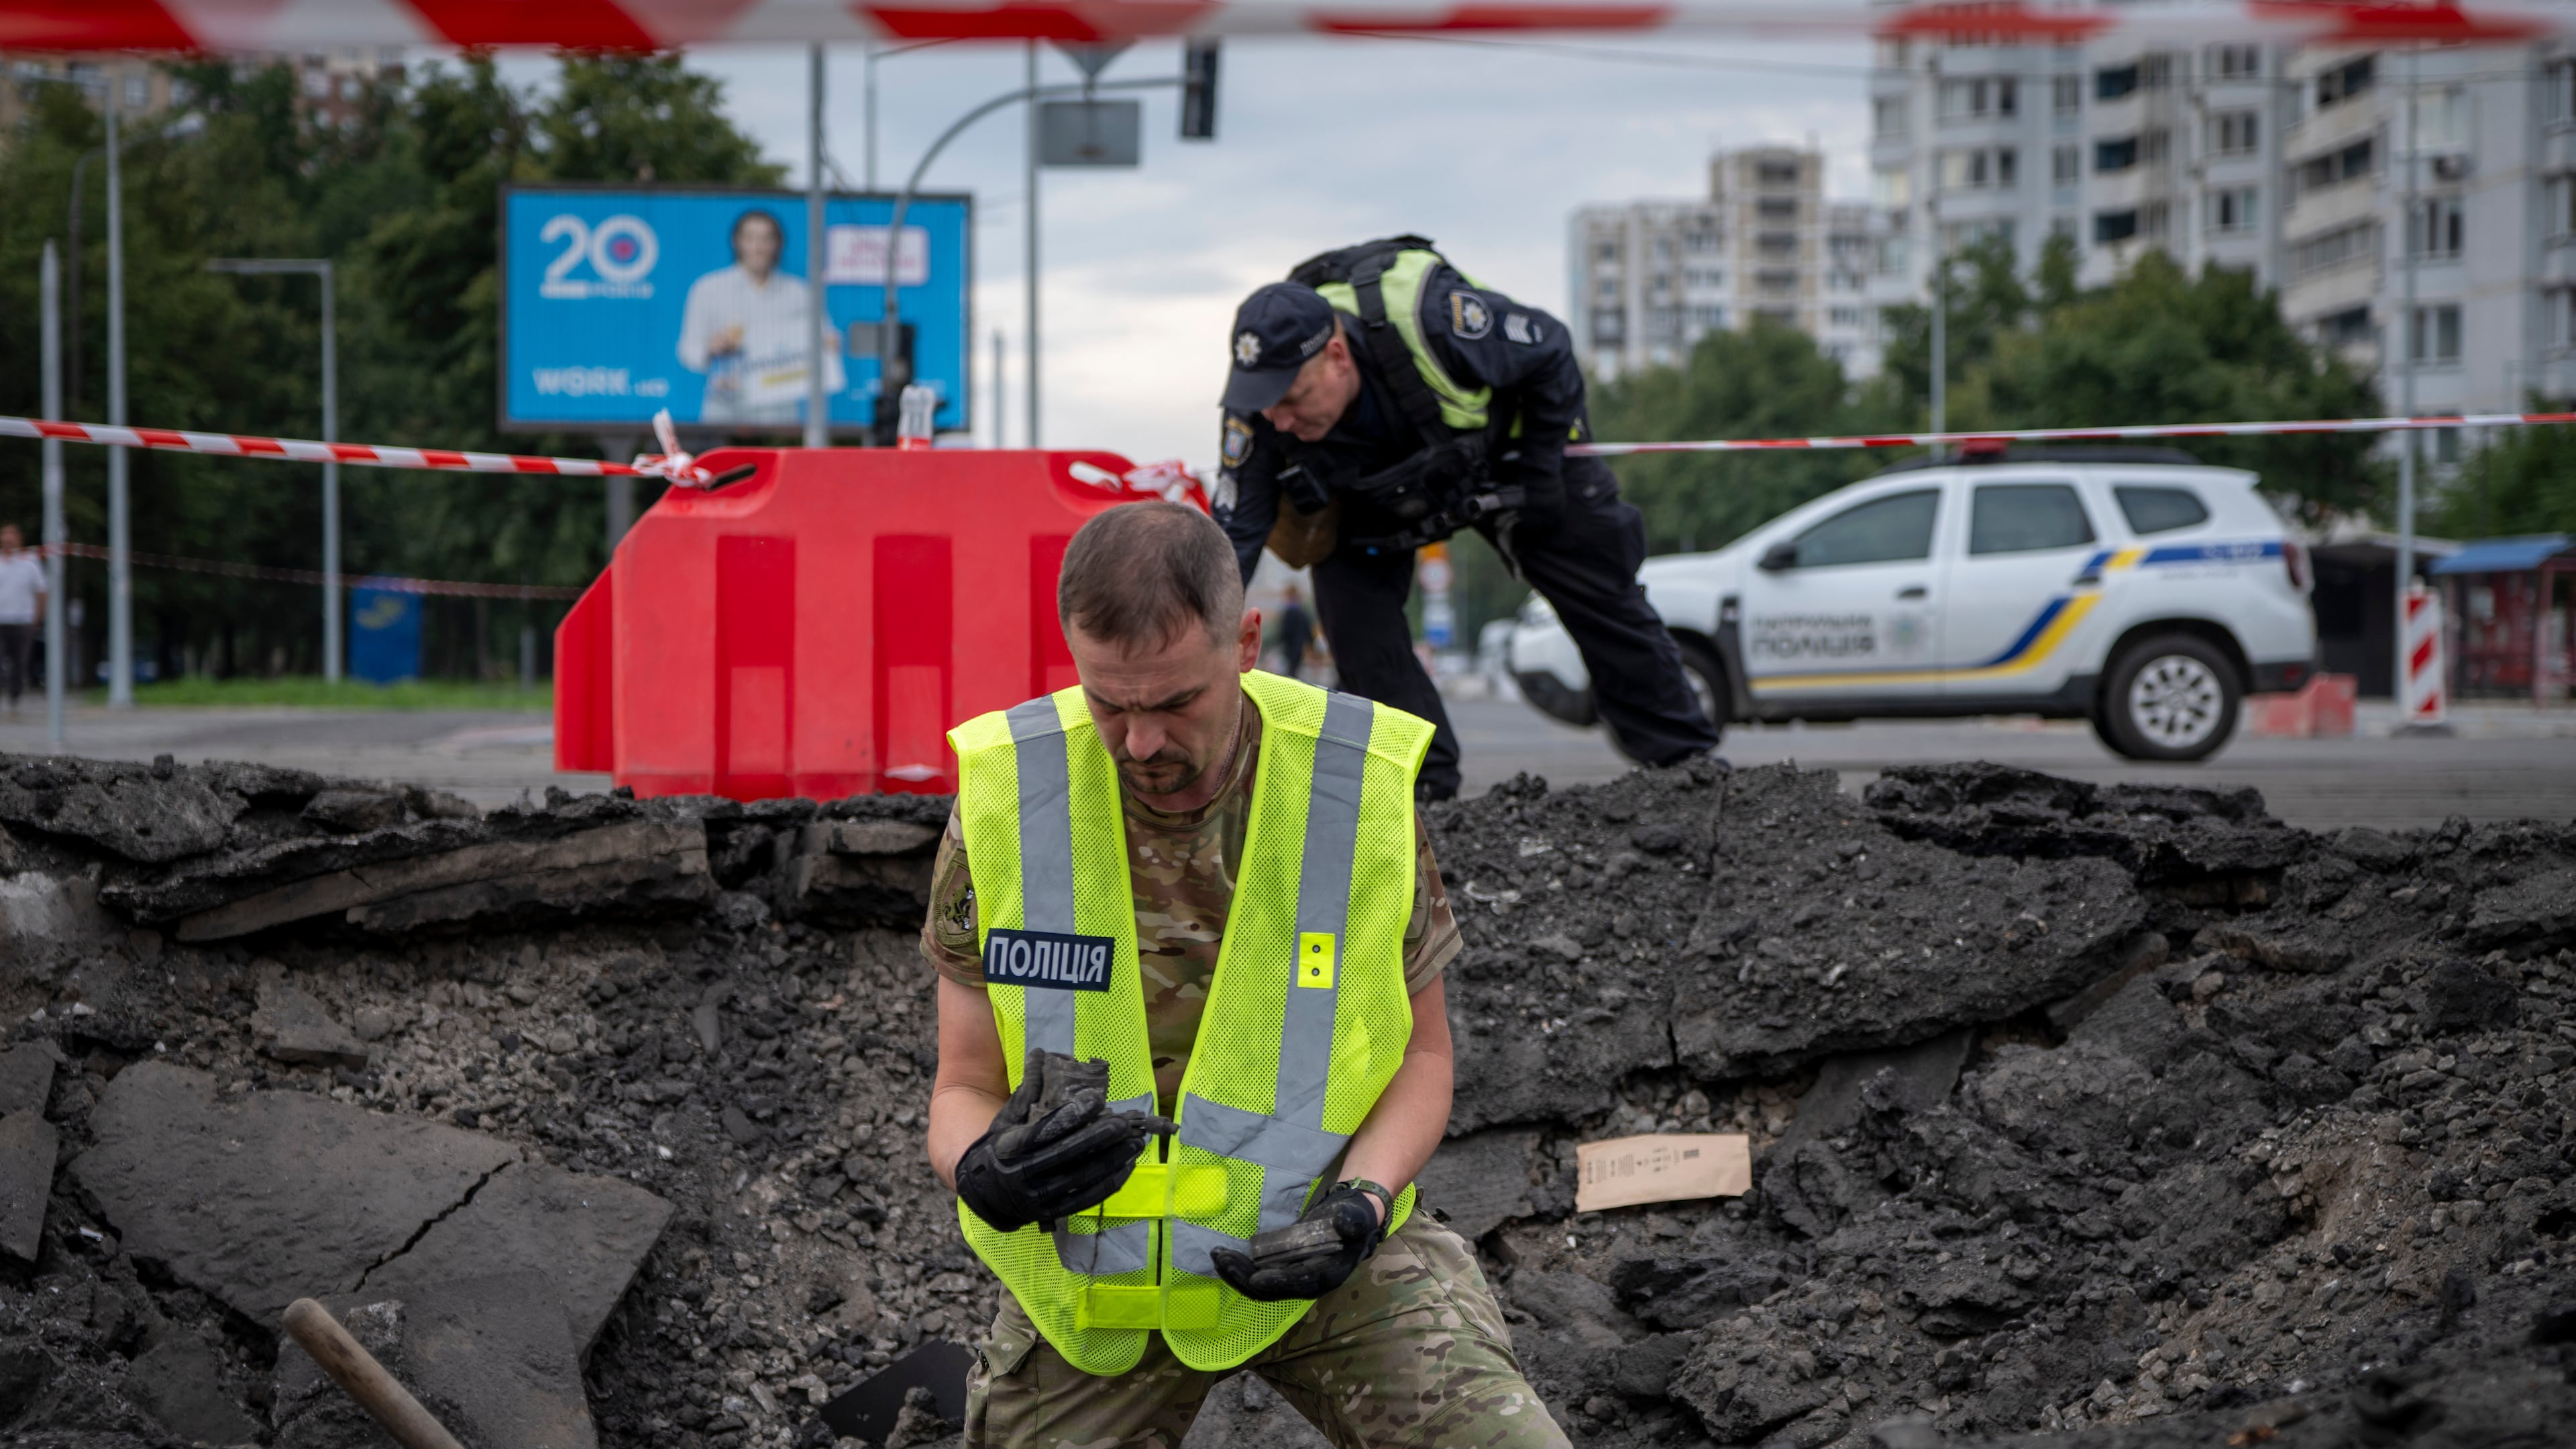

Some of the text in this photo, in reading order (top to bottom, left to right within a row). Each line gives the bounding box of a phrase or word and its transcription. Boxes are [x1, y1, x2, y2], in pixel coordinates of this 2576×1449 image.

[540, 214, 659, 299] 20
[1752, 634, 1876, 659] ПОЛІЦІЯ
[989, 936, 1107, 984] ПОЛІЦІЯ
